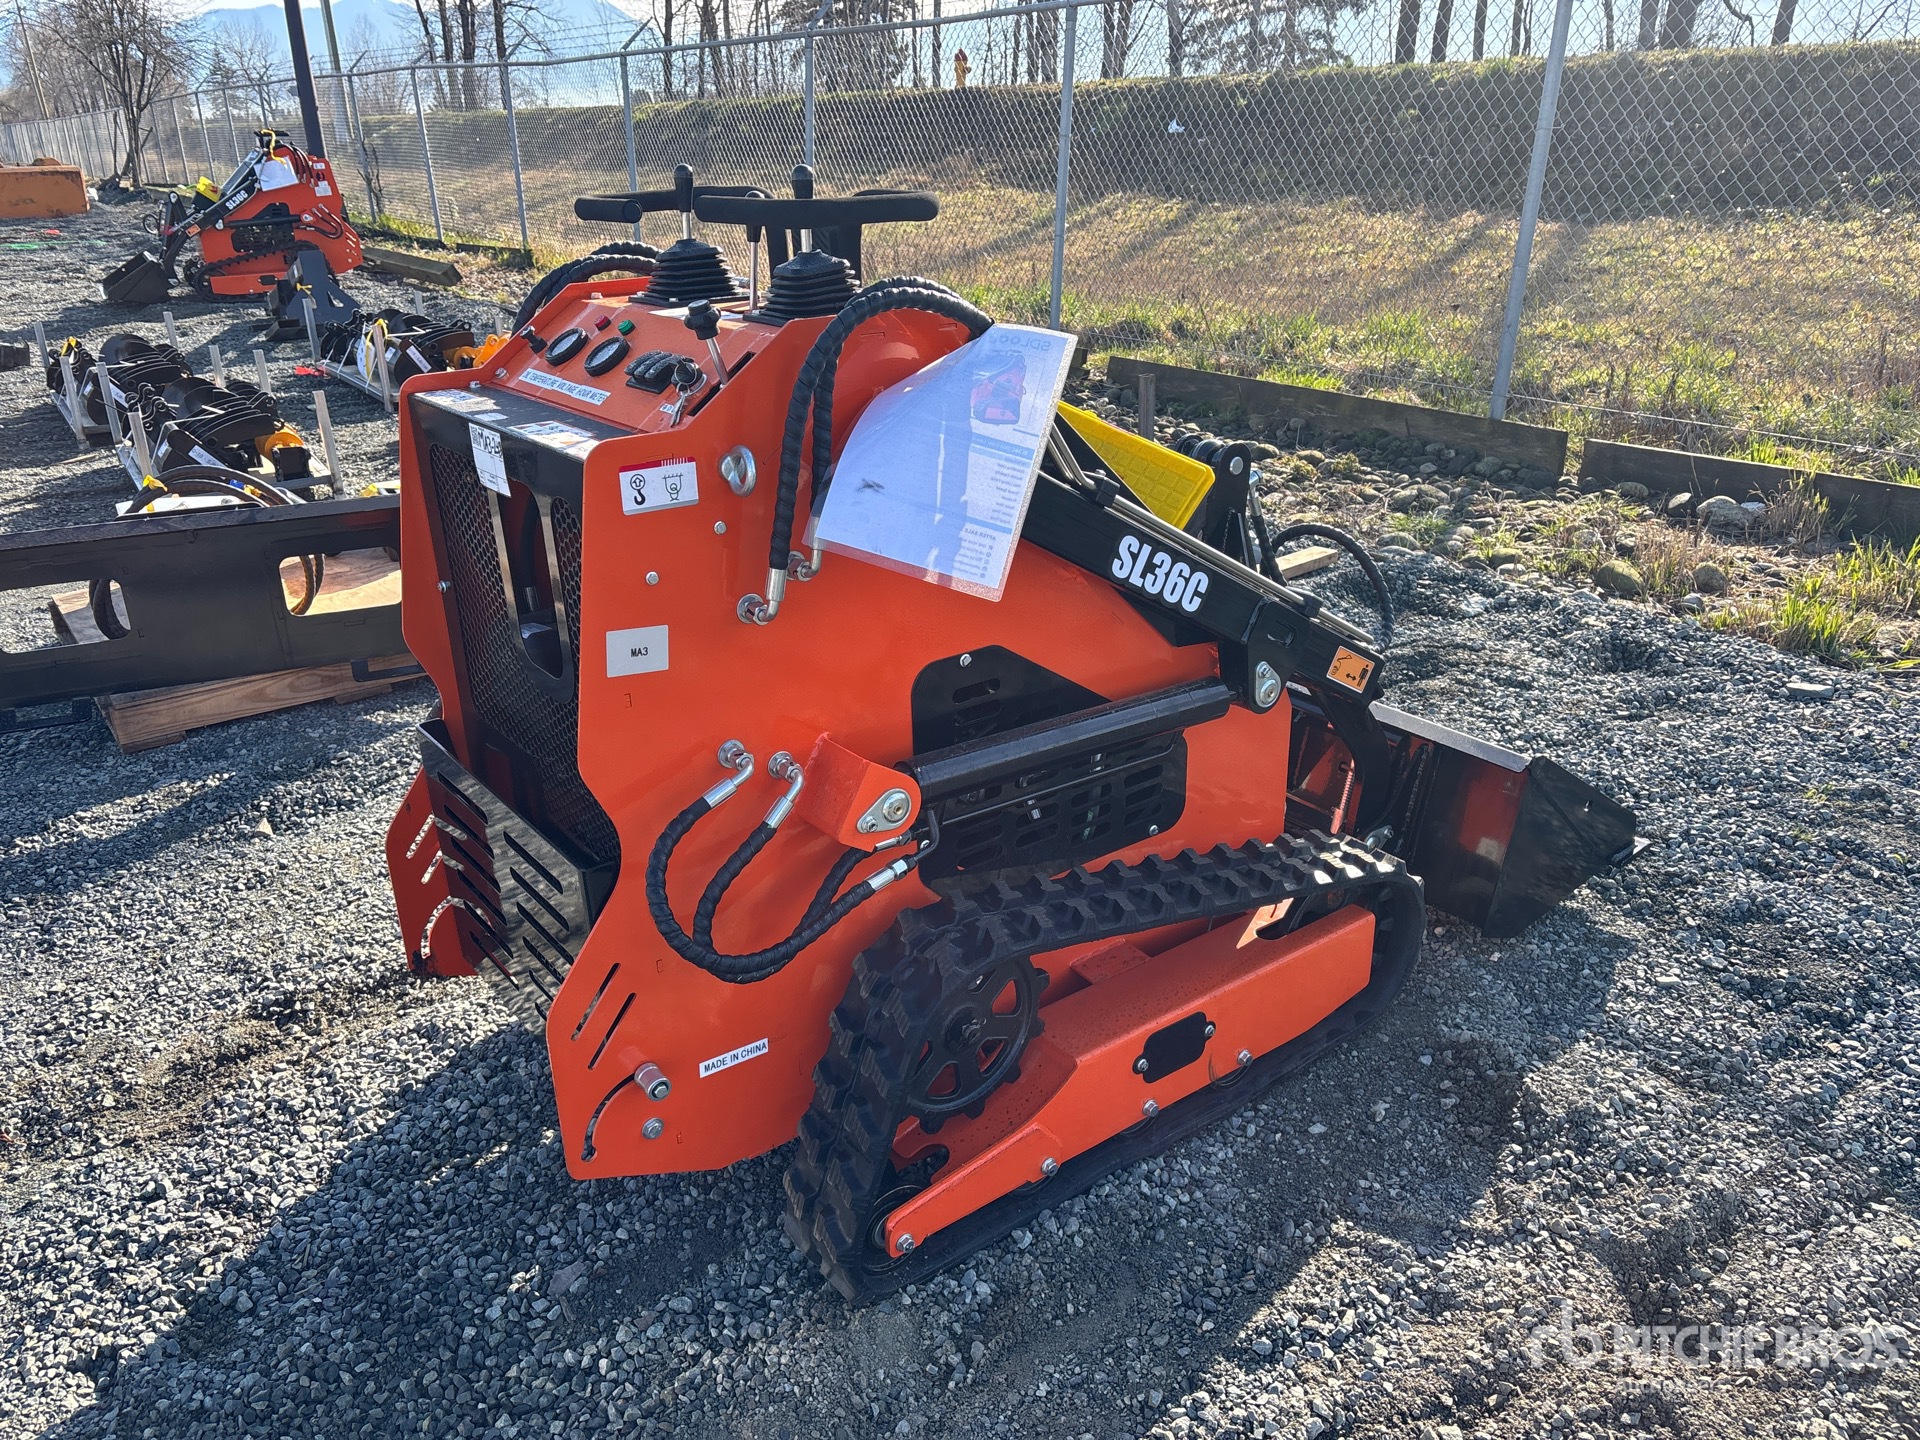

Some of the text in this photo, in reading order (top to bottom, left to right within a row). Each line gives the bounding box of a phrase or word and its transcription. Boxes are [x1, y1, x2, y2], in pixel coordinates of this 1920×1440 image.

[225, 190, 248, 210] SL36C
[529, 372, 559, 388] TEMPERATURE
[557, 381, 578, 394] VOLTAGE
[576, 386, 593, 398] HOUR
[1111, 535, 1209, 612] SL36C
[630, 646, 649, 658] MA3
[704, 1041, 767, 1073] MADE IN CHINA
